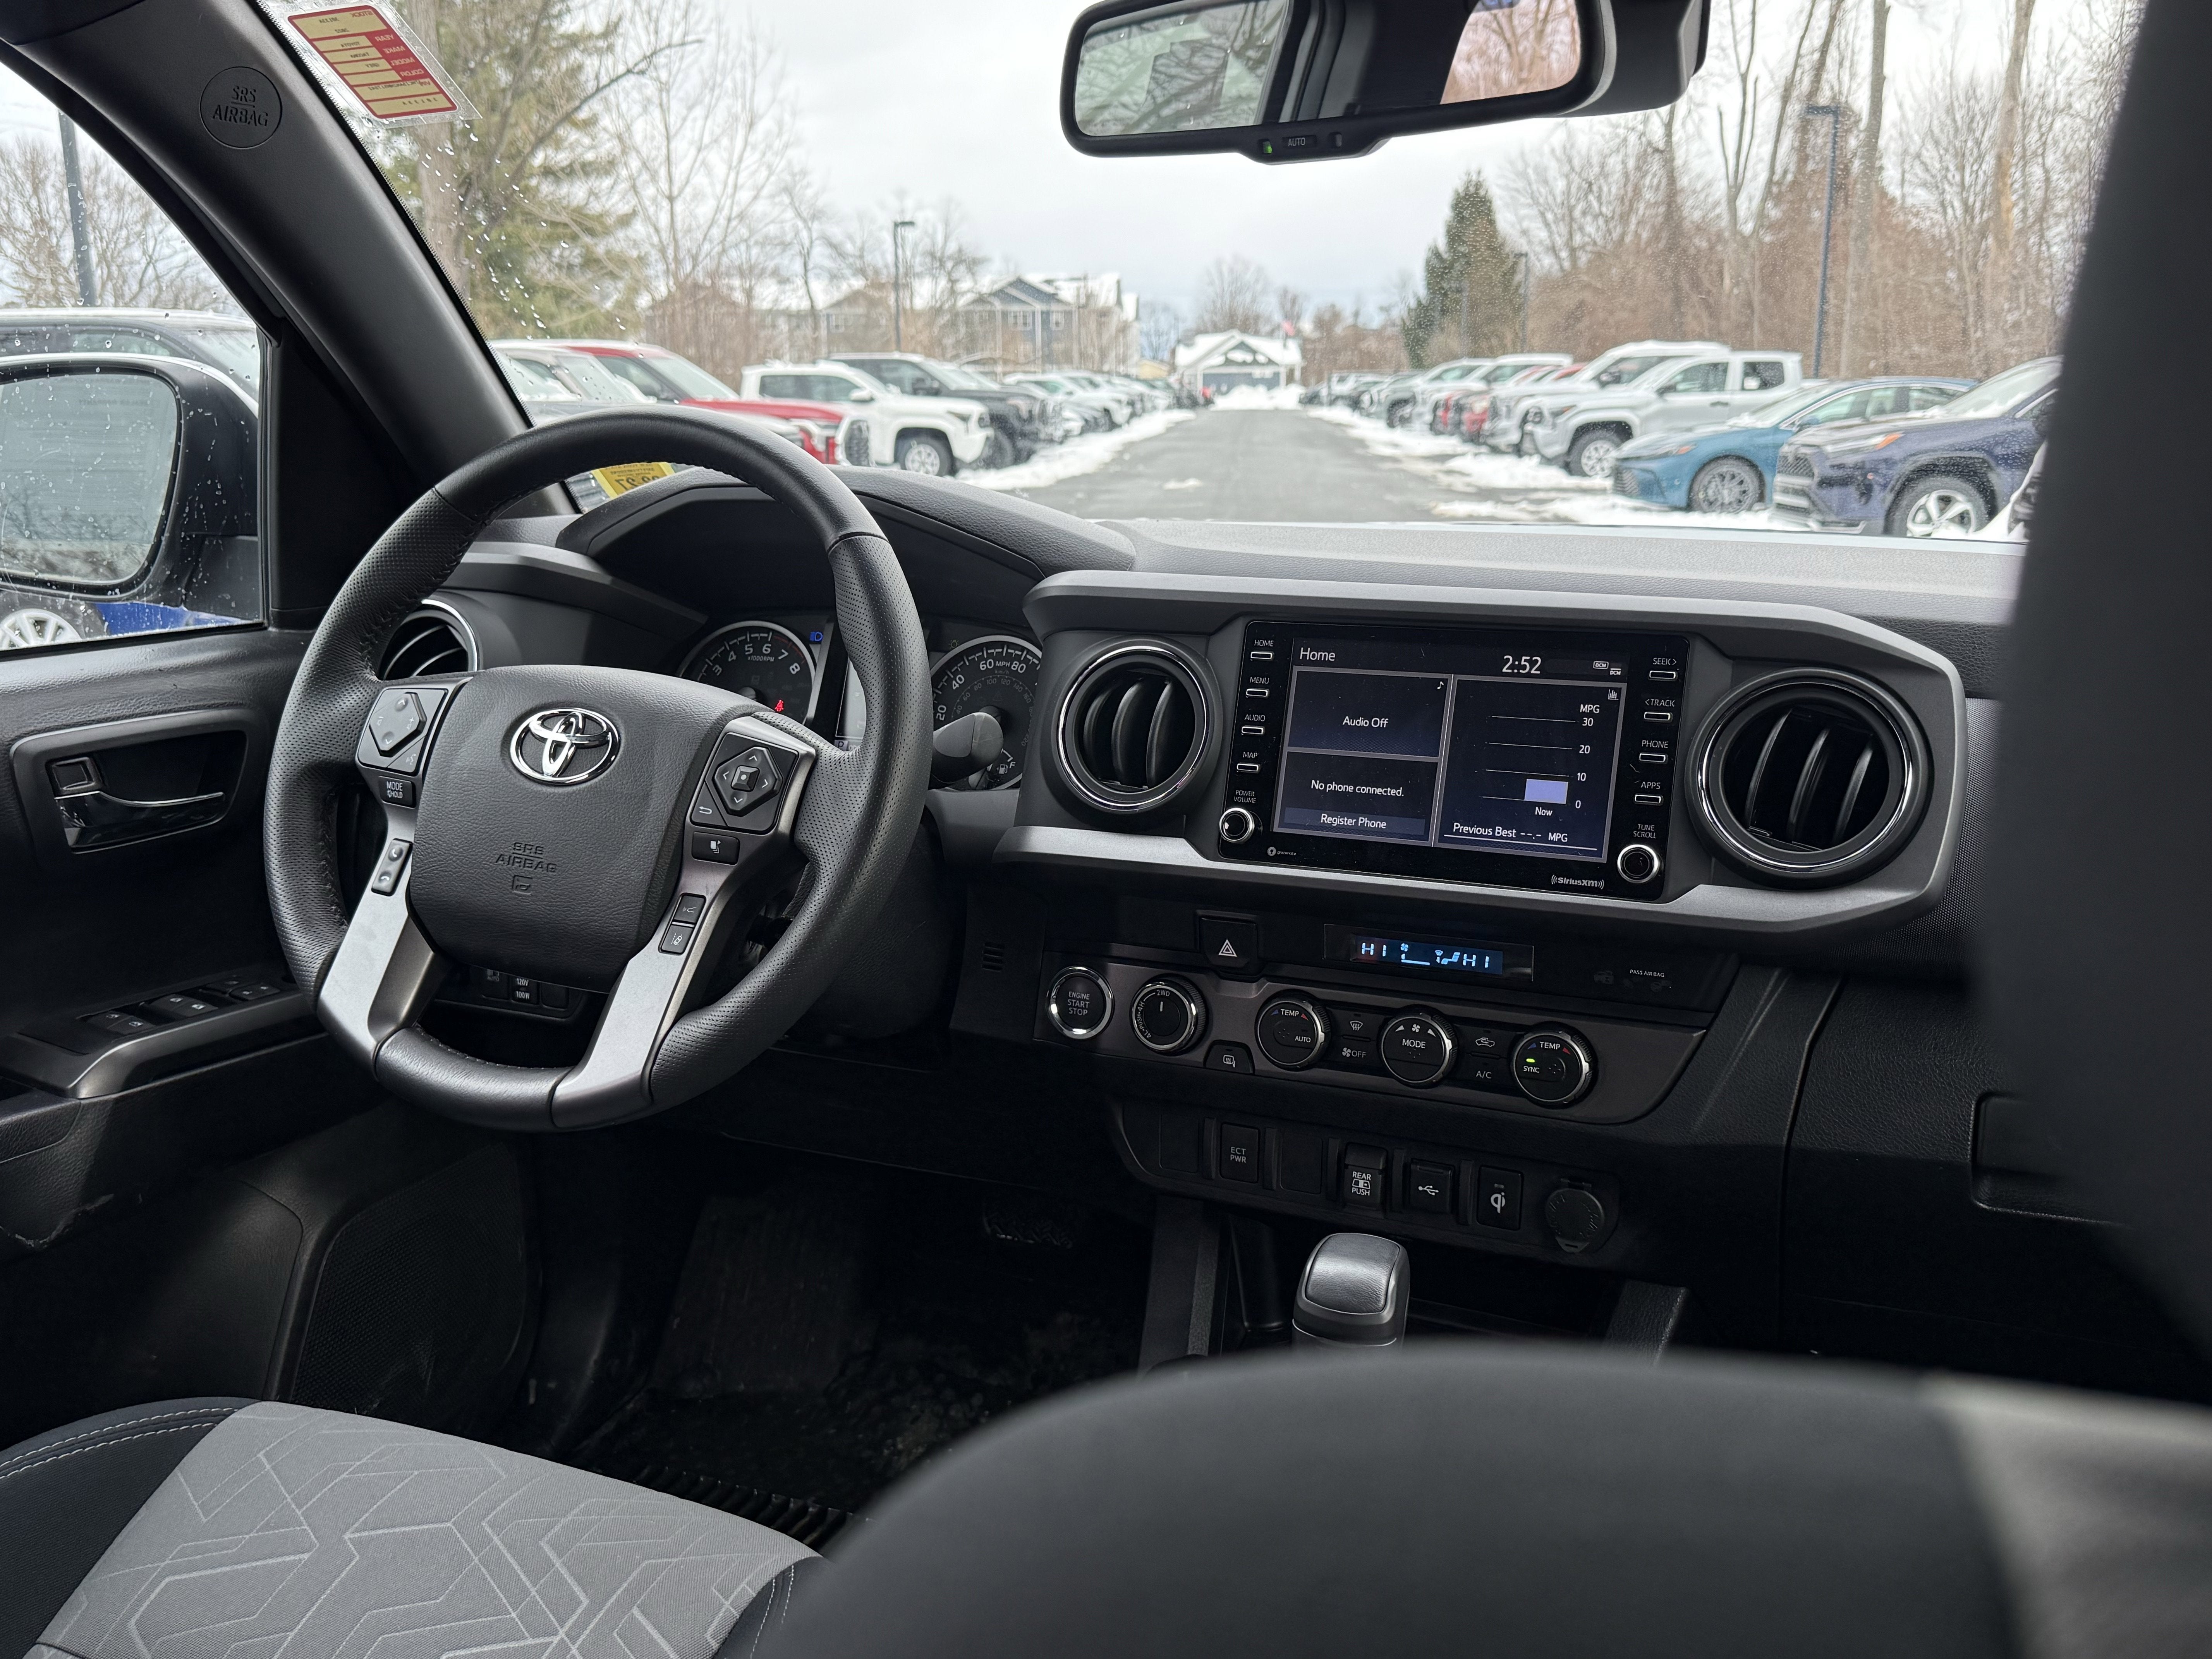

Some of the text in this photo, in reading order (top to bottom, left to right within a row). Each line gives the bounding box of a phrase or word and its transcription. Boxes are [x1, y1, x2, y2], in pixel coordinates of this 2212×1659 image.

[232, 86, 256, 102] SRS
[213, 105, 268, 126] AIRBAG
[1288, 137, 1305, 147] AUTO
[745, 644, 753, 655] 5
[763, 644, 771, 654] 6
[778, 649, 788, 659] 7
[728, 651, 736, 662] 4
[1300, 648, 1336, 661] Home
[789, 663, 800, 675] 8
[980, 659, 994, 670] 60
[1011, 661, 1026, 673] 80
[1502, 655, 1542, 674] 2:52
[713, 665, 722, 676] 3
[952, 674, 965, 690] 40
[1013, 683, 1023, 692] 140
[936, 705, 946, 721] 20
[957, 705, 962, 714] 40
[1580, 704, 1600, 713] MPG
[1343, 716, 1388, 728] Audio Off
[1582, 718, 1594, 727] 30
[1579, 745, 1590, 754] 20
[1642, 740, 1669, 749] PHONE
[1577, 773, 1586, 781] 10
[387, 781, 403, 791] MODE
[1311, 780, 1404, 797] No phone connected.
[1575, 800, 1581, 809] 0
[1535, 807, 1553, 816] Now
[1321, 814, 1386, 828] Register Phone
[1453, 823, 1492, 836] Previous
[1495, 827, 1516, 838] Best
[1549, 833, 1568, 843] MPG
[1633, 831, 1657, 839] SCROLL
[1362, 943, 1387, 957] HI
[1463, 953, 1489, 968] HI
[517, 978, 529, 986] 120V
[517, 991, 529, 999] 100W
[1068, 991, 1090, 1000] ENGINE
[1067, 999, 1090, 1008] START
[1402, 1039, 1426, 1048] MODE
[1539, 1041, 1561, 1050] TEMP
[1476, 1070, 1492, 1079] A/C
[1230, 1147, 1246, 1155] ECT
[1230, 1155, 1246, 1163] PWR
[1352, 1171, 1371, 1181] REAR
[1352, 1187, 1370, 1196] PUSH
